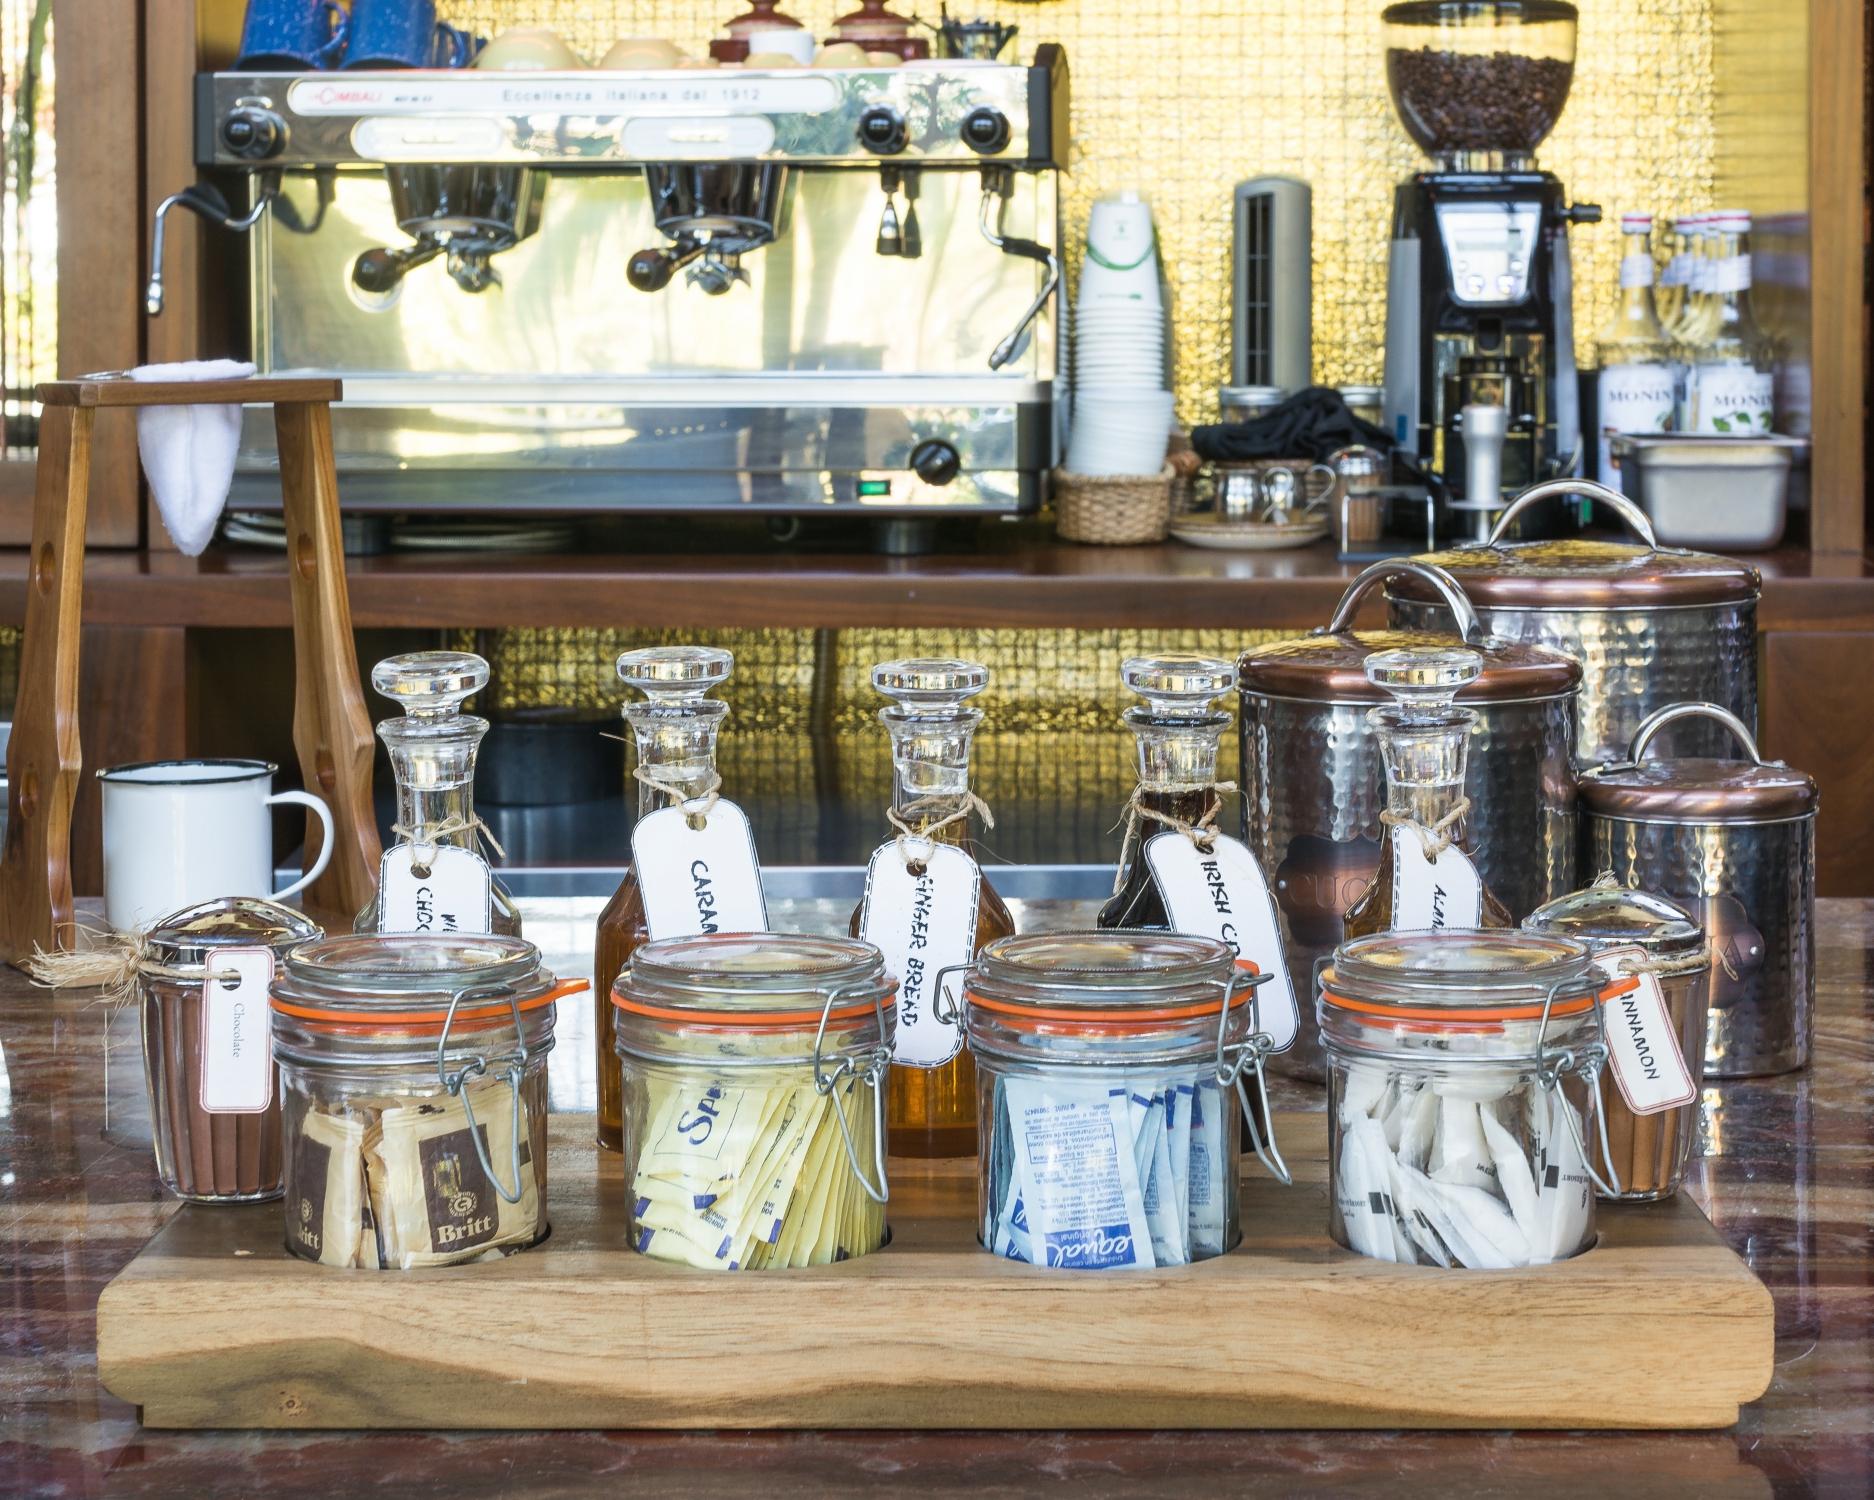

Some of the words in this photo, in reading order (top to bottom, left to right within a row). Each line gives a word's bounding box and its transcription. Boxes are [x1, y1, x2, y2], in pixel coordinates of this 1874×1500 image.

[503, 88, 593, 102] Eccellenza
[721, 88, 761, 101] 1912
[909, 873, 934, 951] GINGER
[1200, 860, 1233, 914] IRISH
[900, 956, 926, 1027] BREAD
[232, 1002, 246, 1058] Chocolate
[436, 1214, 494, 1245] Britt
[1046, 1229, 1133, 1269] equal
